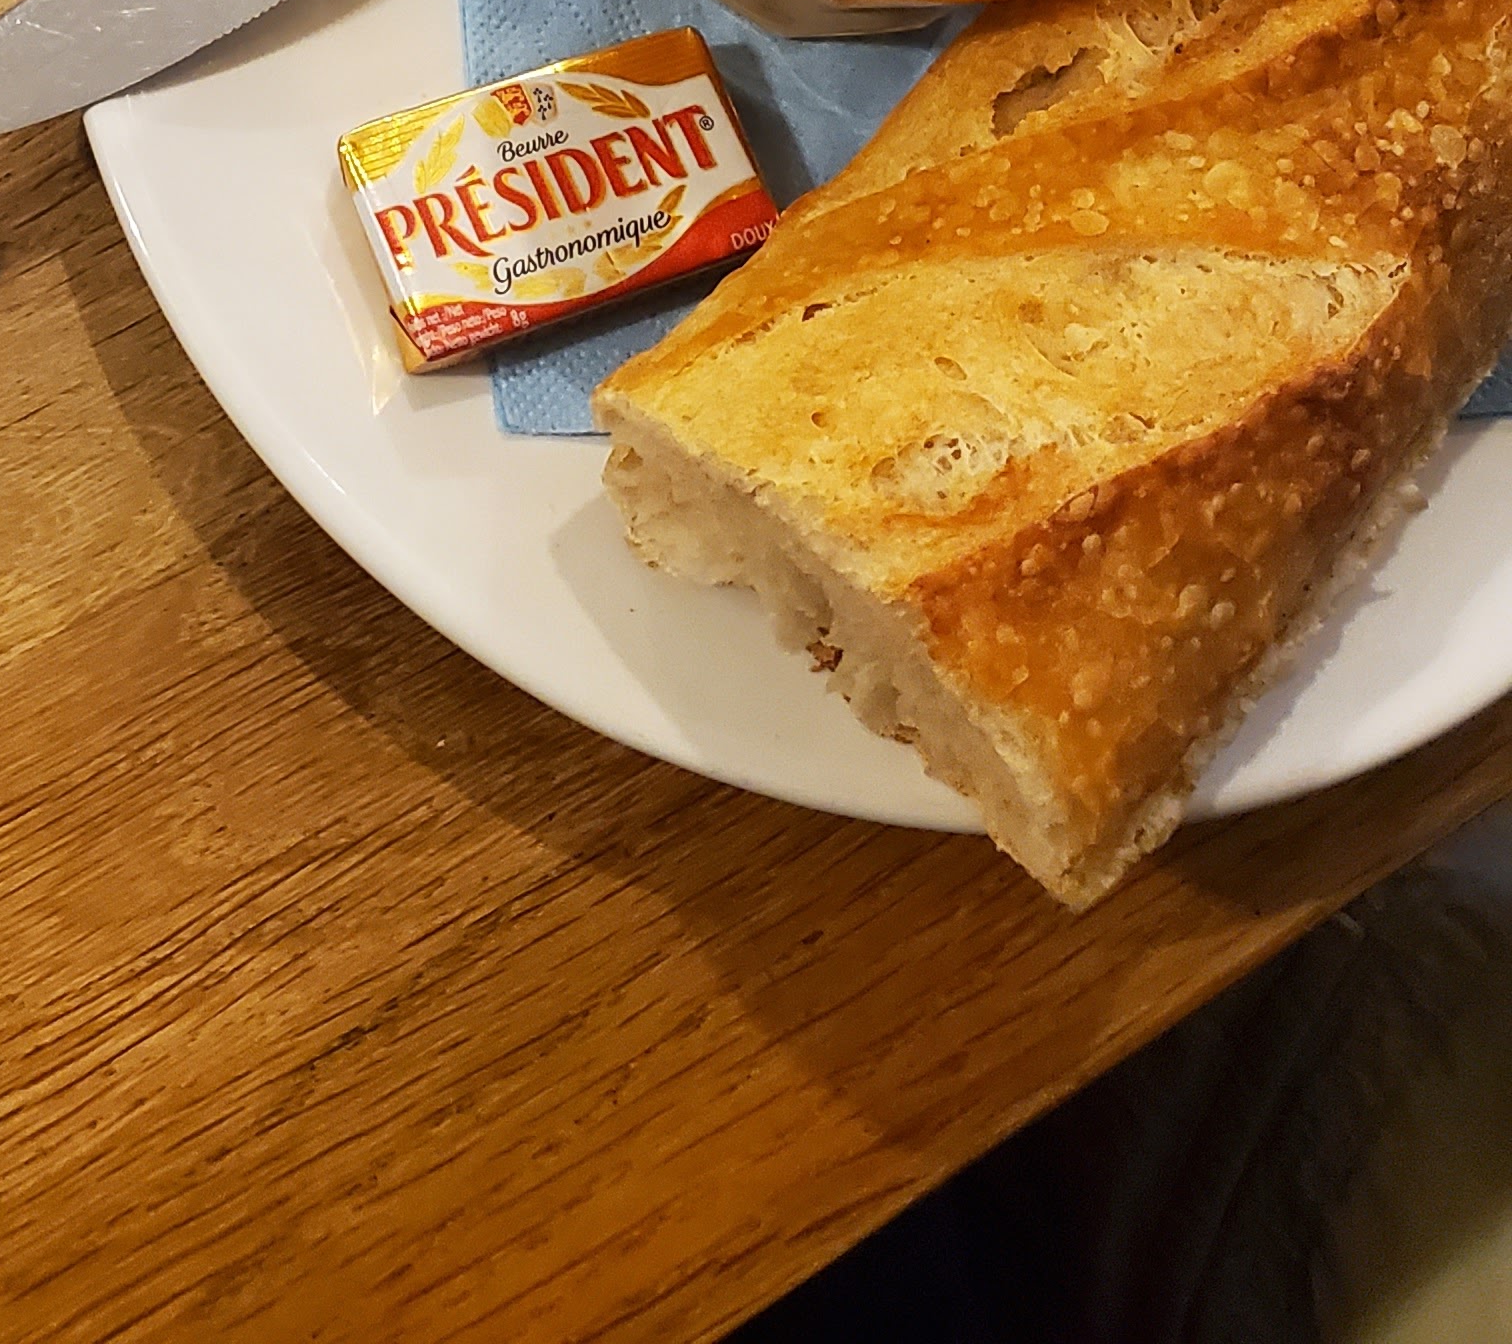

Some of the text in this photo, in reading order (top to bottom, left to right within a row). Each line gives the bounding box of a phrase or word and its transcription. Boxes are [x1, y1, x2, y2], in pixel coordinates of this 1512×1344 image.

[497, 128, 569, 162] Beurre
[374, 104, 717, 271] PRÉSIDENT
[492, 210, 671, 294] Gastronomique
[512, 309, 529, 328] 8g
